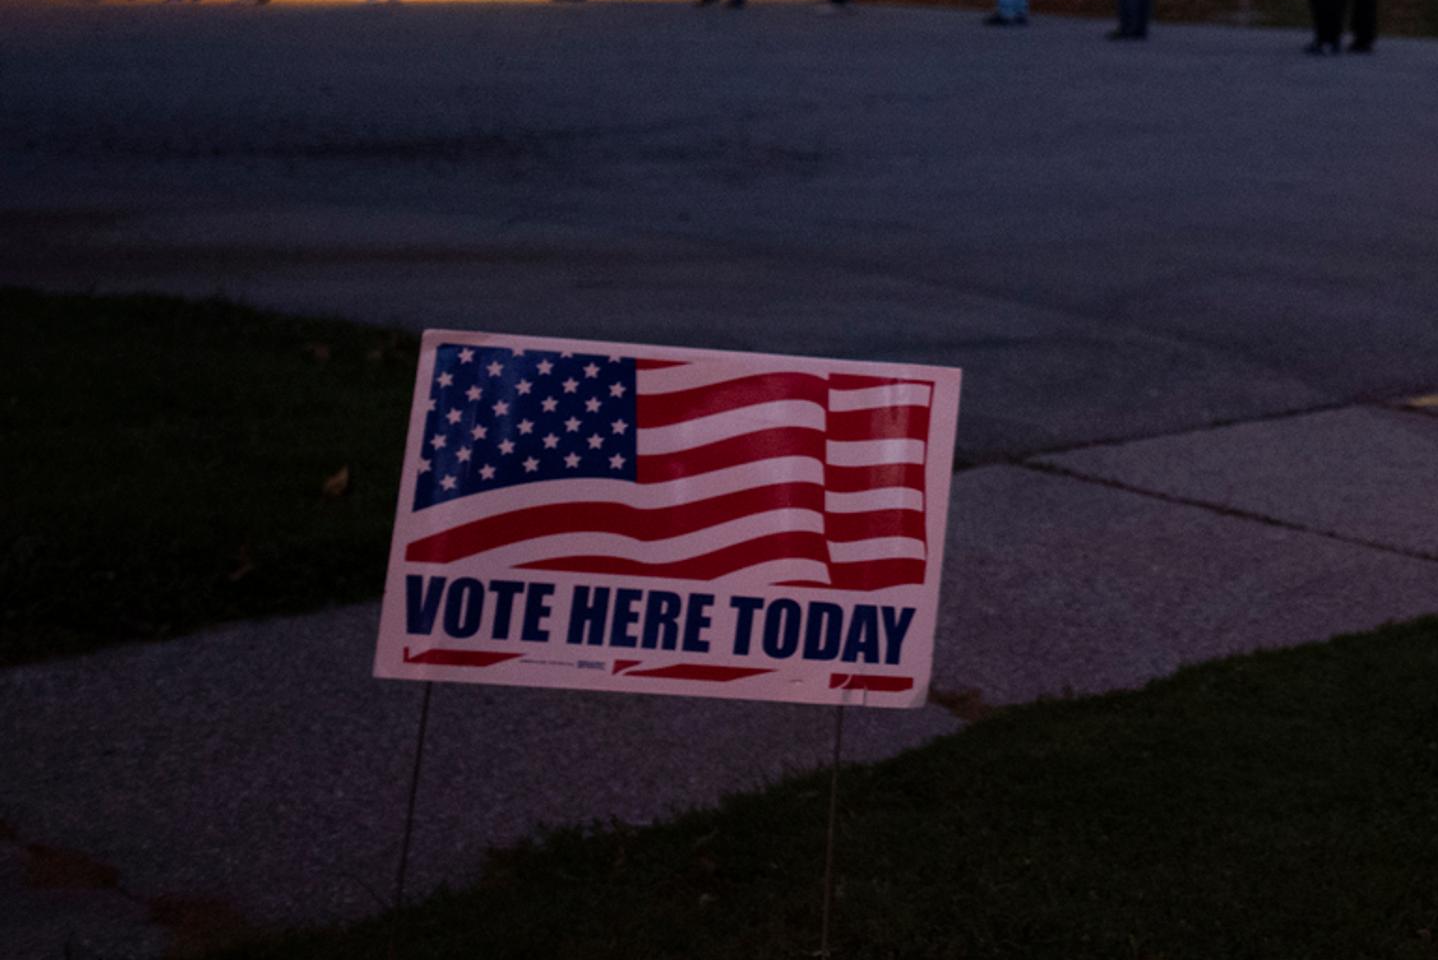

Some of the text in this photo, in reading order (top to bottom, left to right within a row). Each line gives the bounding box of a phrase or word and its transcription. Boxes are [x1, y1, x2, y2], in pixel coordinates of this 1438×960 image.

[405, 574, 916, 665] VOTE HERE TODAY
